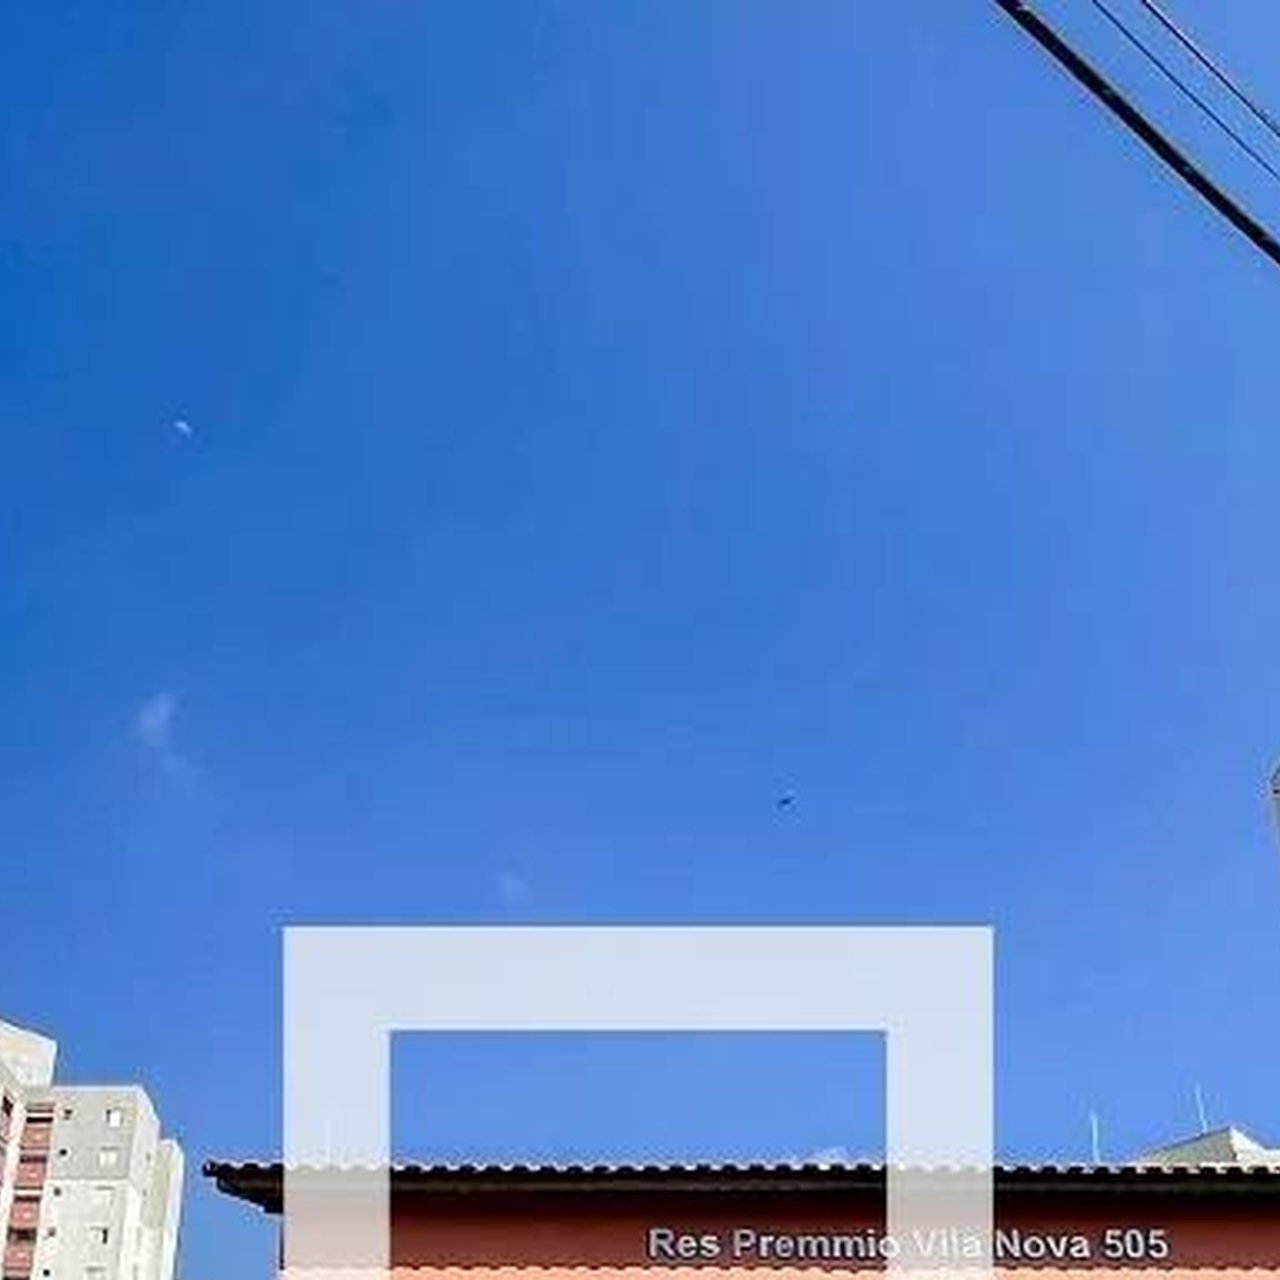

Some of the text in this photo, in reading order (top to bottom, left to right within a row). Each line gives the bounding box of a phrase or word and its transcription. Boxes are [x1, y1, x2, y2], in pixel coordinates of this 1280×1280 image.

[648, 1228, 1169, 1258] Res Premmio Vila Nova 505
